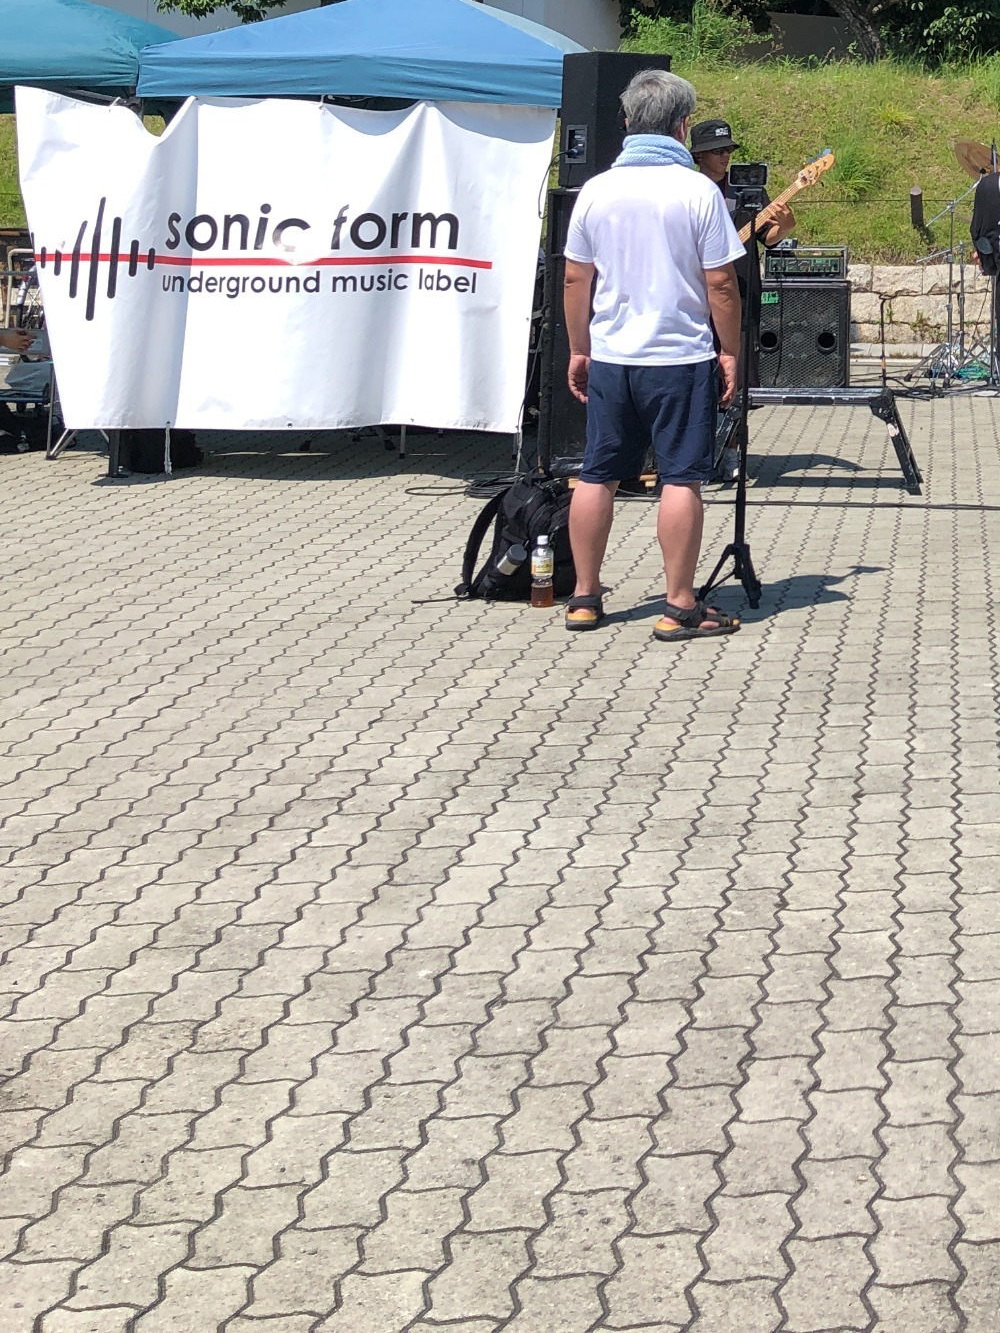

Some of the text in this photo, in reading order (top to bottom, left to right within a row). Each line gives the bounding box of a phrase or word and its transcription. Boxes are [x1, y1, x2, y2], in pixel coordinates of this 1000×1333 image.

[165, 203, 460, 252] sonic form
[162, 268, 477, 299] underground music label
